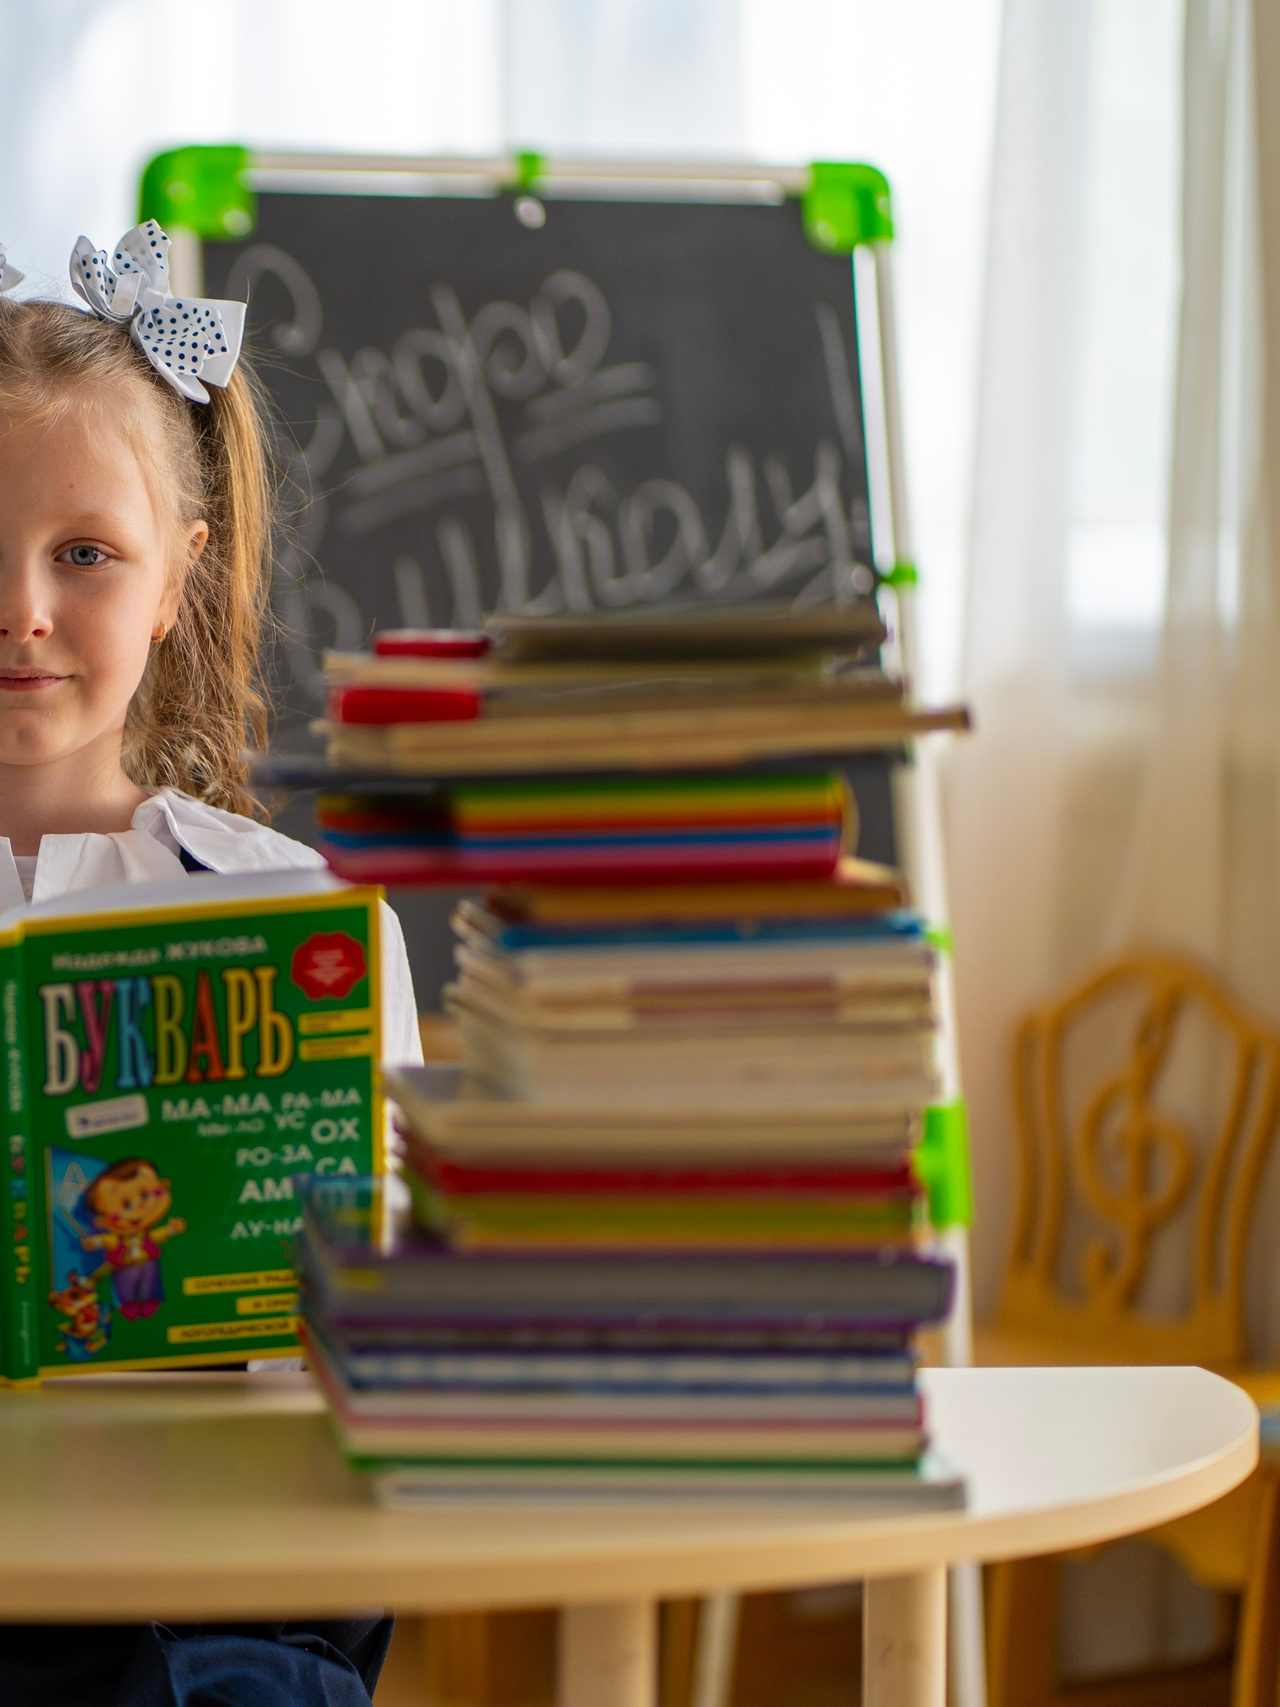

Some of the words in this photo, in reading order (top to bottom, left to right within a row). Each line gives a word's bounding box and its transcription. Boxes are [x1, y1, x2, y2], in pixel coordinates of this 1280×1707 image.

[165, 934, 268, 961] ЖУКОВА
[38, 964, 294, 1096] БУКВАРЬ
[161, 1092, 272, 1122] МА-МА
[280, 1087, 362, 1111] РА-МА
[274, 1109, 306, 1131] УС
[311, 1116, 360, 1145] ОХ
[235, 1144, 313, 1167] РО-ЗА
